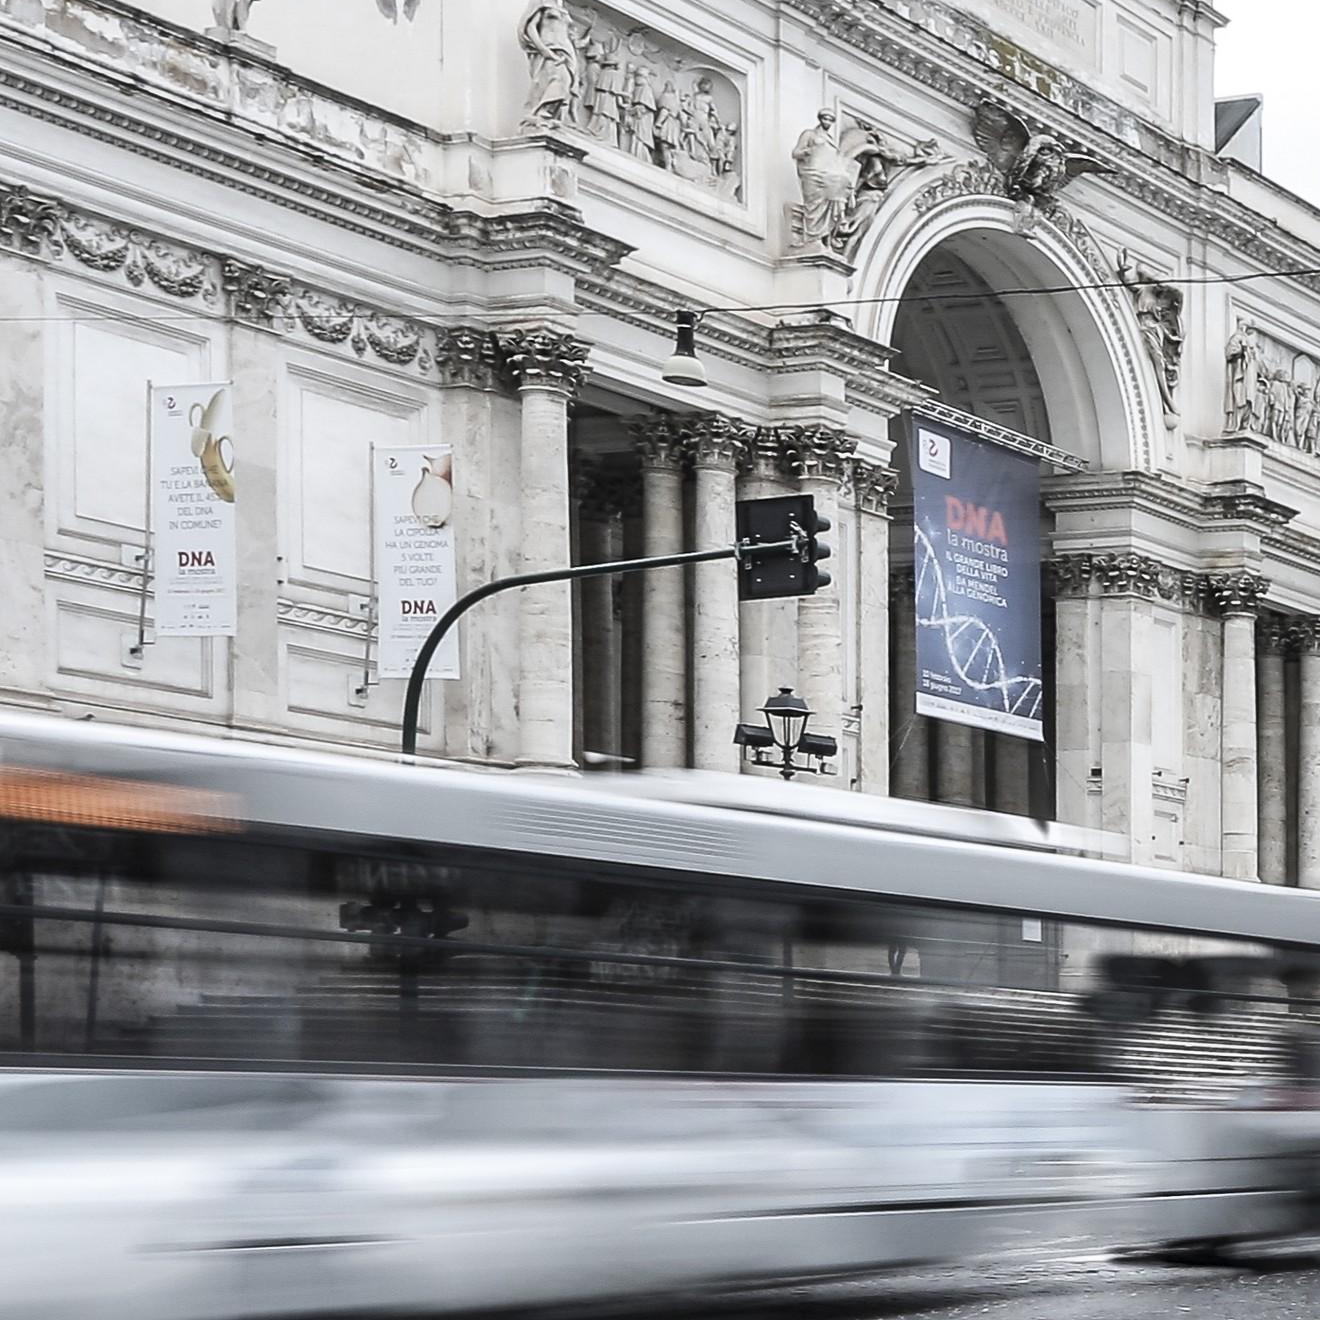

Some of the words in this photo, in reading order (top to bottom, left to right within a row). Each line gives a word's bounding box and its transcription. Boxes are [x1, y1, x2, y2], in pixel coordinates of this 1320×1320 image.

[944, 494, 1009, 546] DNA
[947, 528, 959, 547] la
[961, 538, 1009, 562] mostra
[178, 551, 215, 567] DNA
[401, 600, 437, 614] DNA
